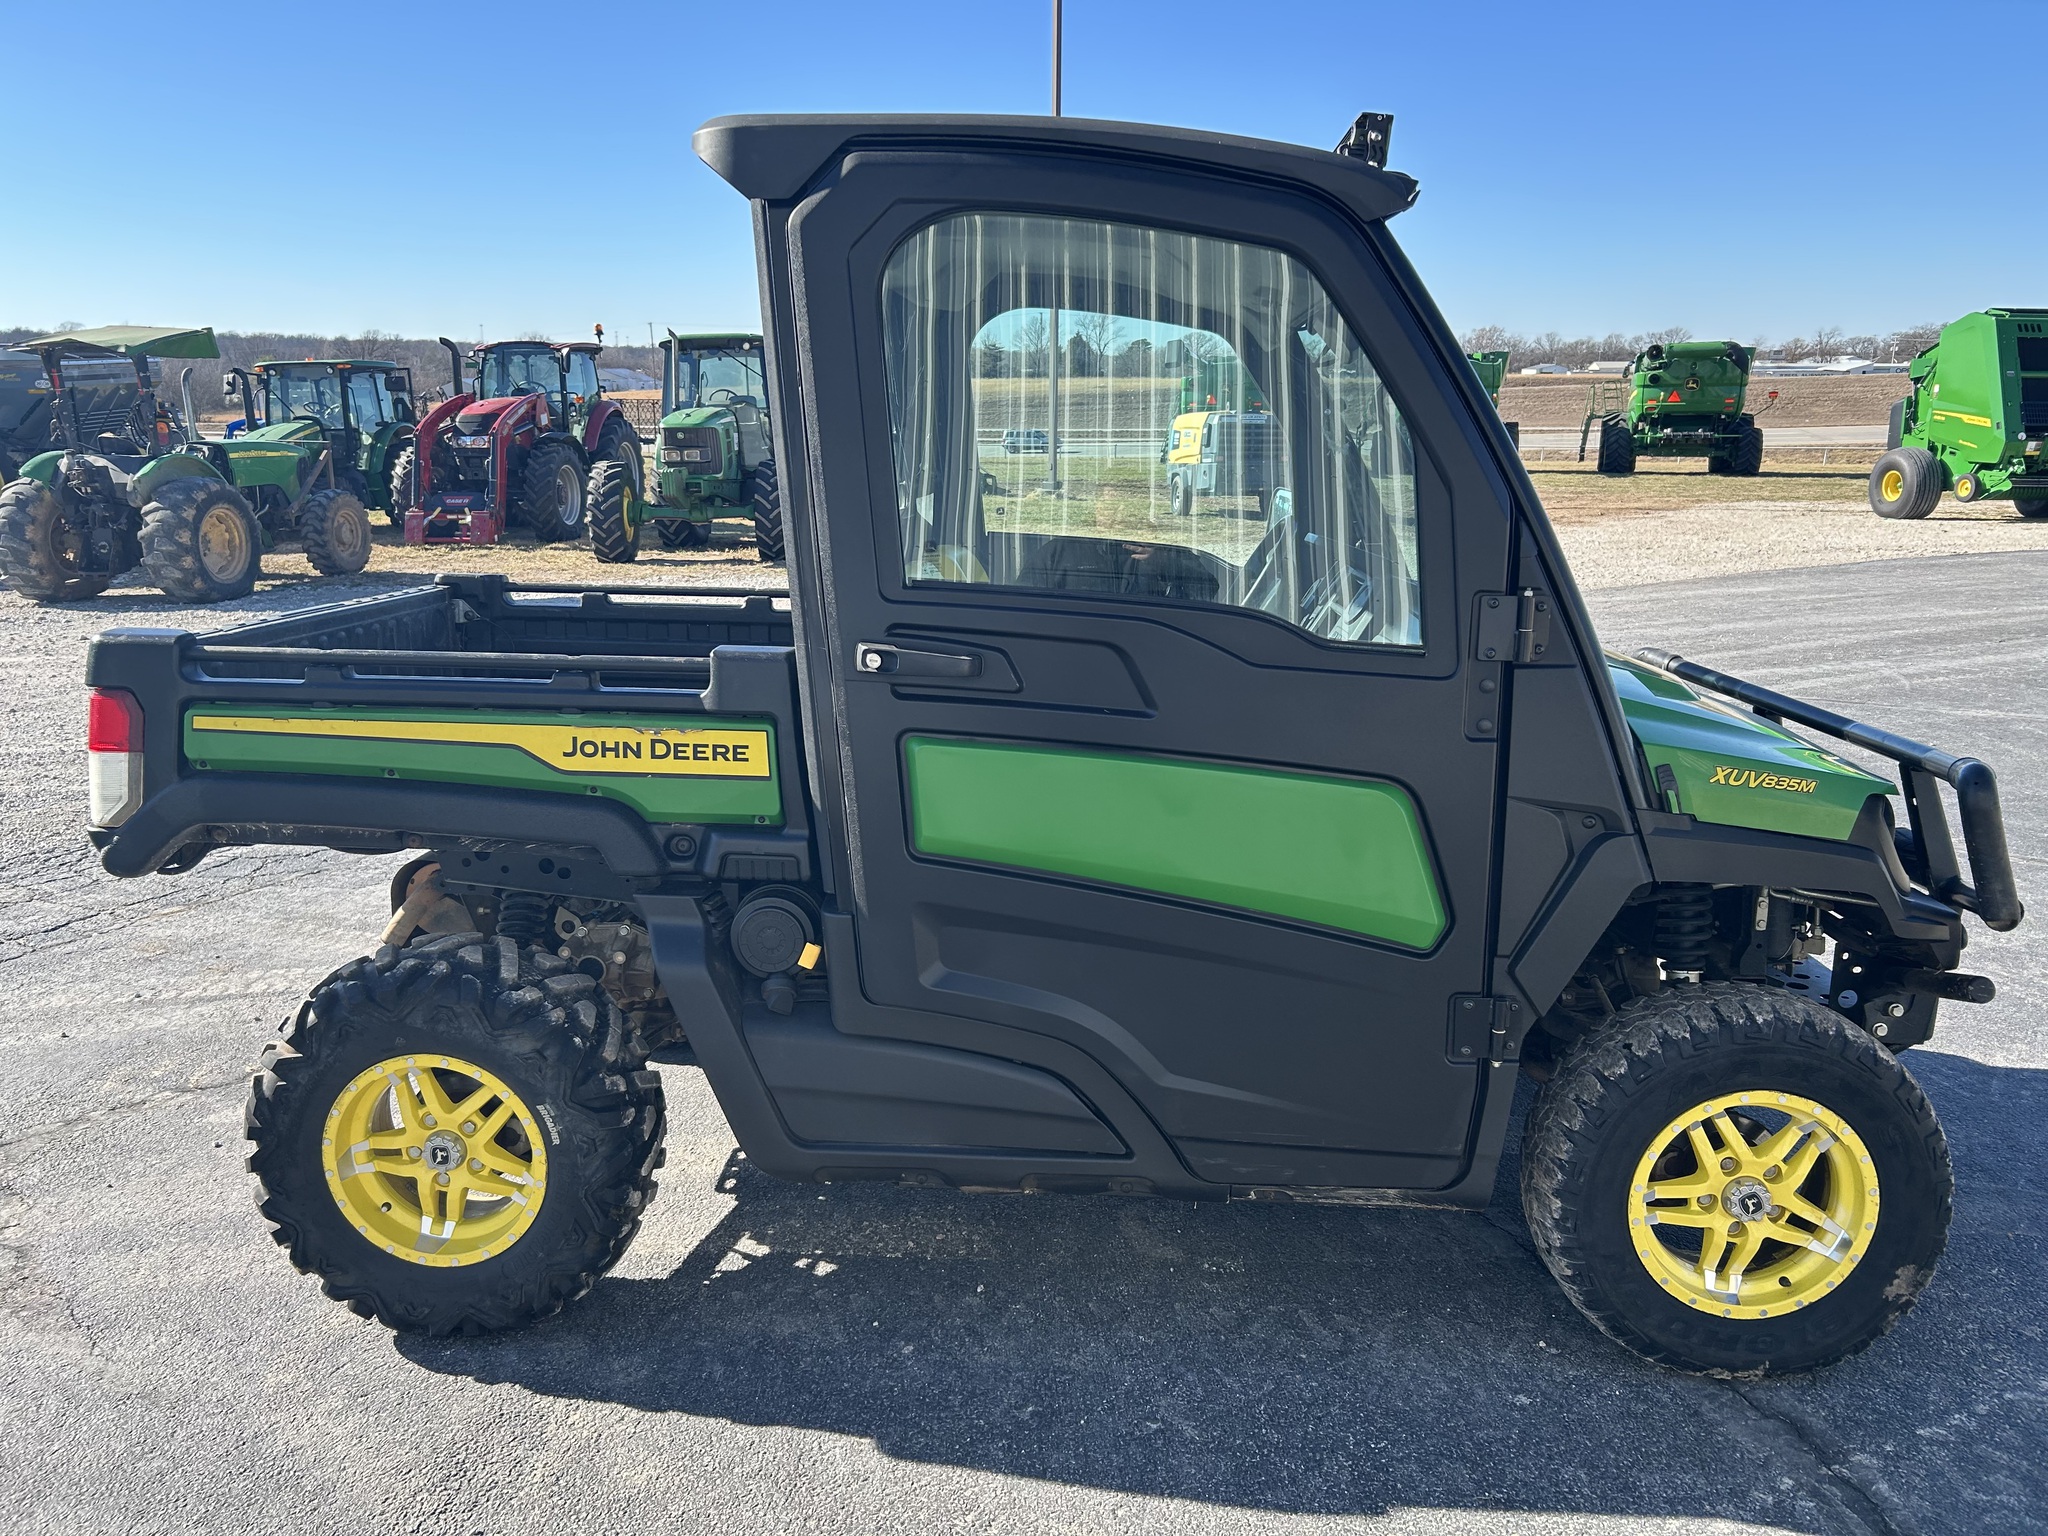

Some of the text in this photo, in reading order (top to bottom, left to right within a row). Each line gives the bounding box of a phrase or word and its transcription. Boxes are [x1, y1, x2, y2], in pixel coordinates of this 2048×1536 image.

[562, 736, 750, 762] JOHN DEERE
[1709, 766, 1817, 793] XUV835M
[536, 1104, 560, 1146] BRIGADIER
